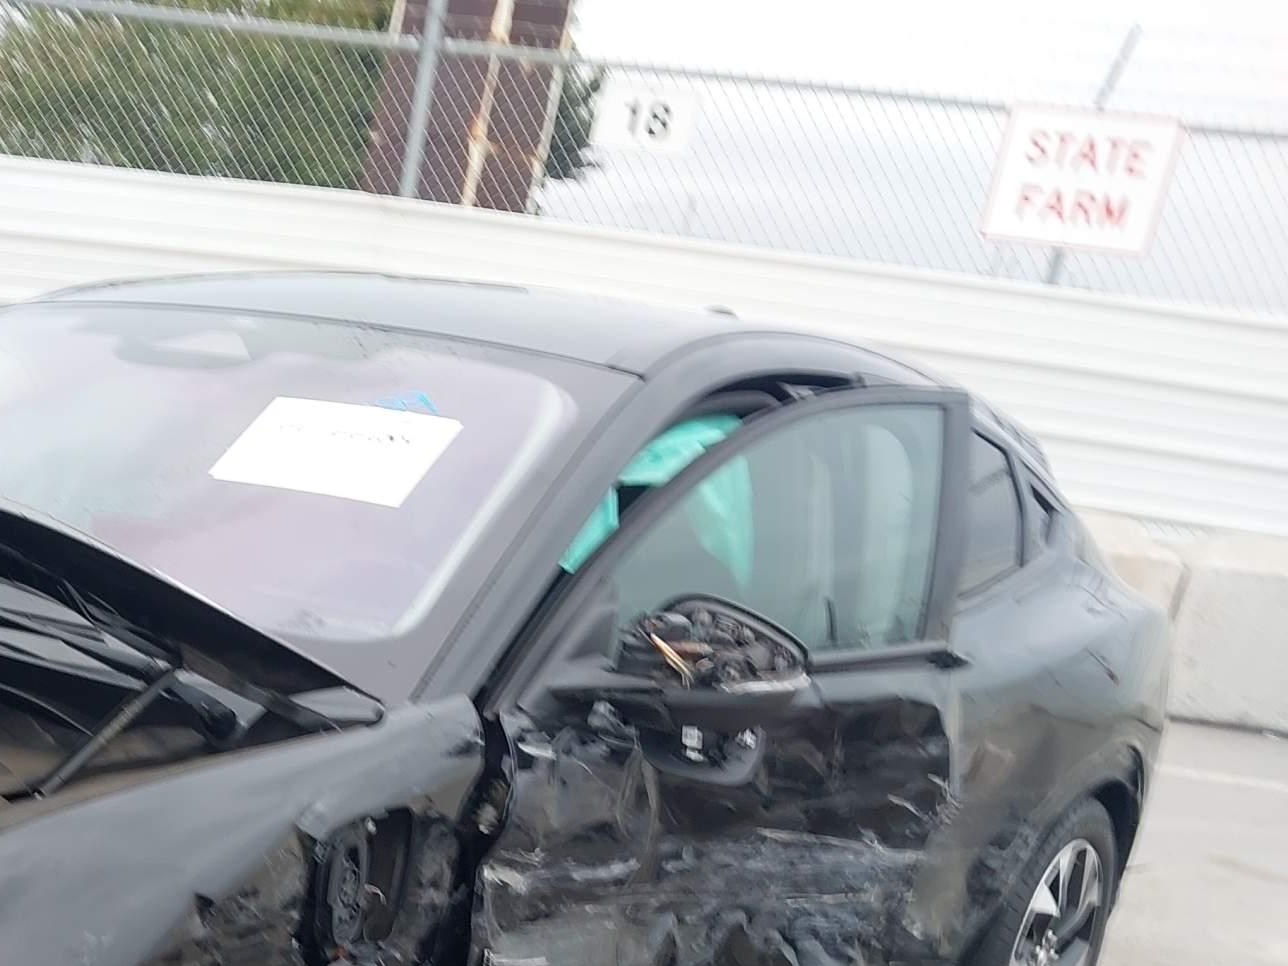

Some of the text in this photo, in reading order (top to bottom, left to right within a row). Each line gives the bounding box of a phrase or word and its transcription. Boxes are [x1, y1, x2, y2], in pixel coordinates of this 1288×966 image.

[624, 98, 672, 140] 18
[1025, 128, 1153, 179] STATE
[1016, 182, 1128, 231] FARM
